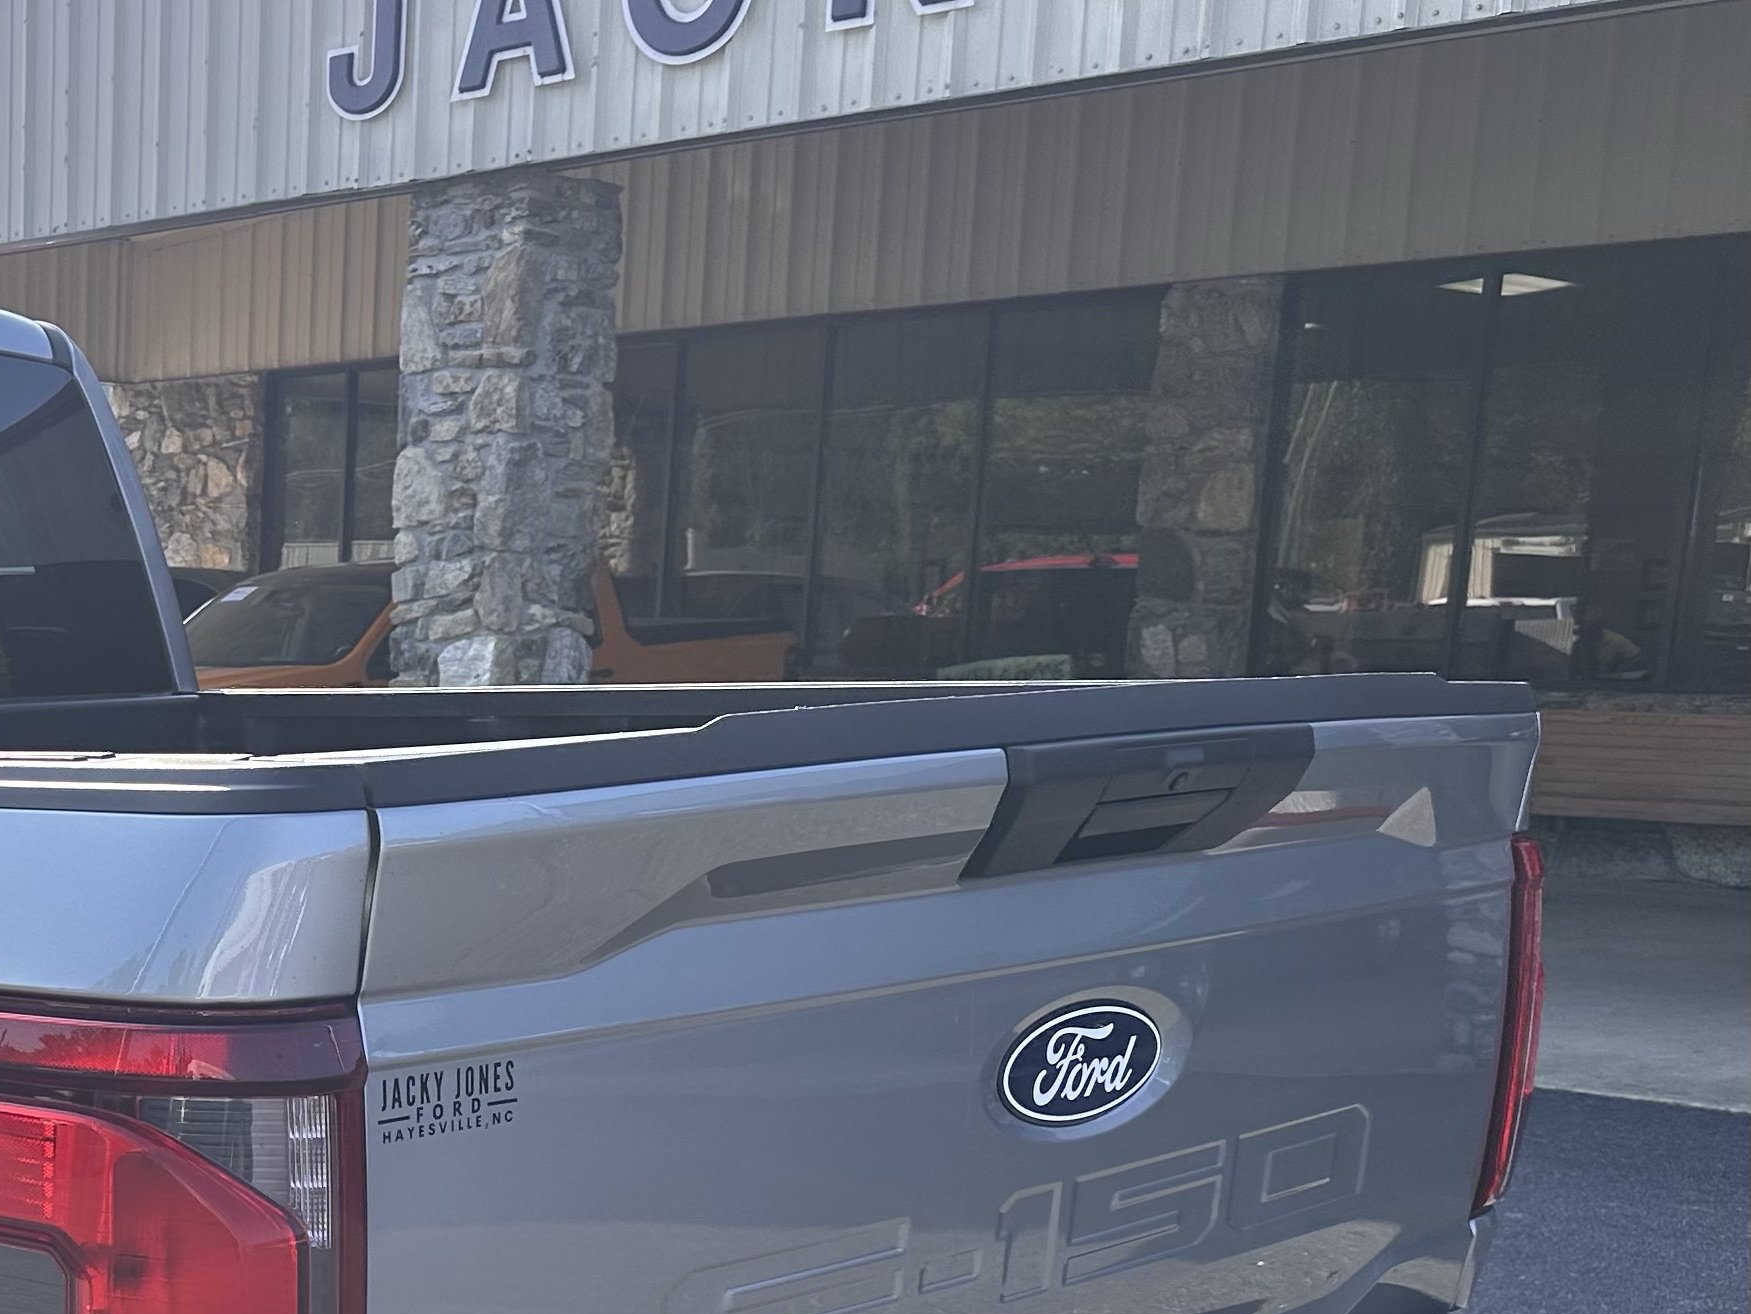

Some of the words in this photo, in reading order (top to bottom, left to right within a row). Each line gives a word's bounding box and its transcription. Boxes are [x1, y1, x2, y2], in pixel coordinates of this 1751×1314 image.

[327, 0, 979, 121] JA
[381, 1071, 444, 1112] JACKY
[455, 1060, 515, 1099] JONES
[1033, 1022, 1137, 1106] Ford
[416, 1097, 482, 1123] FORD
